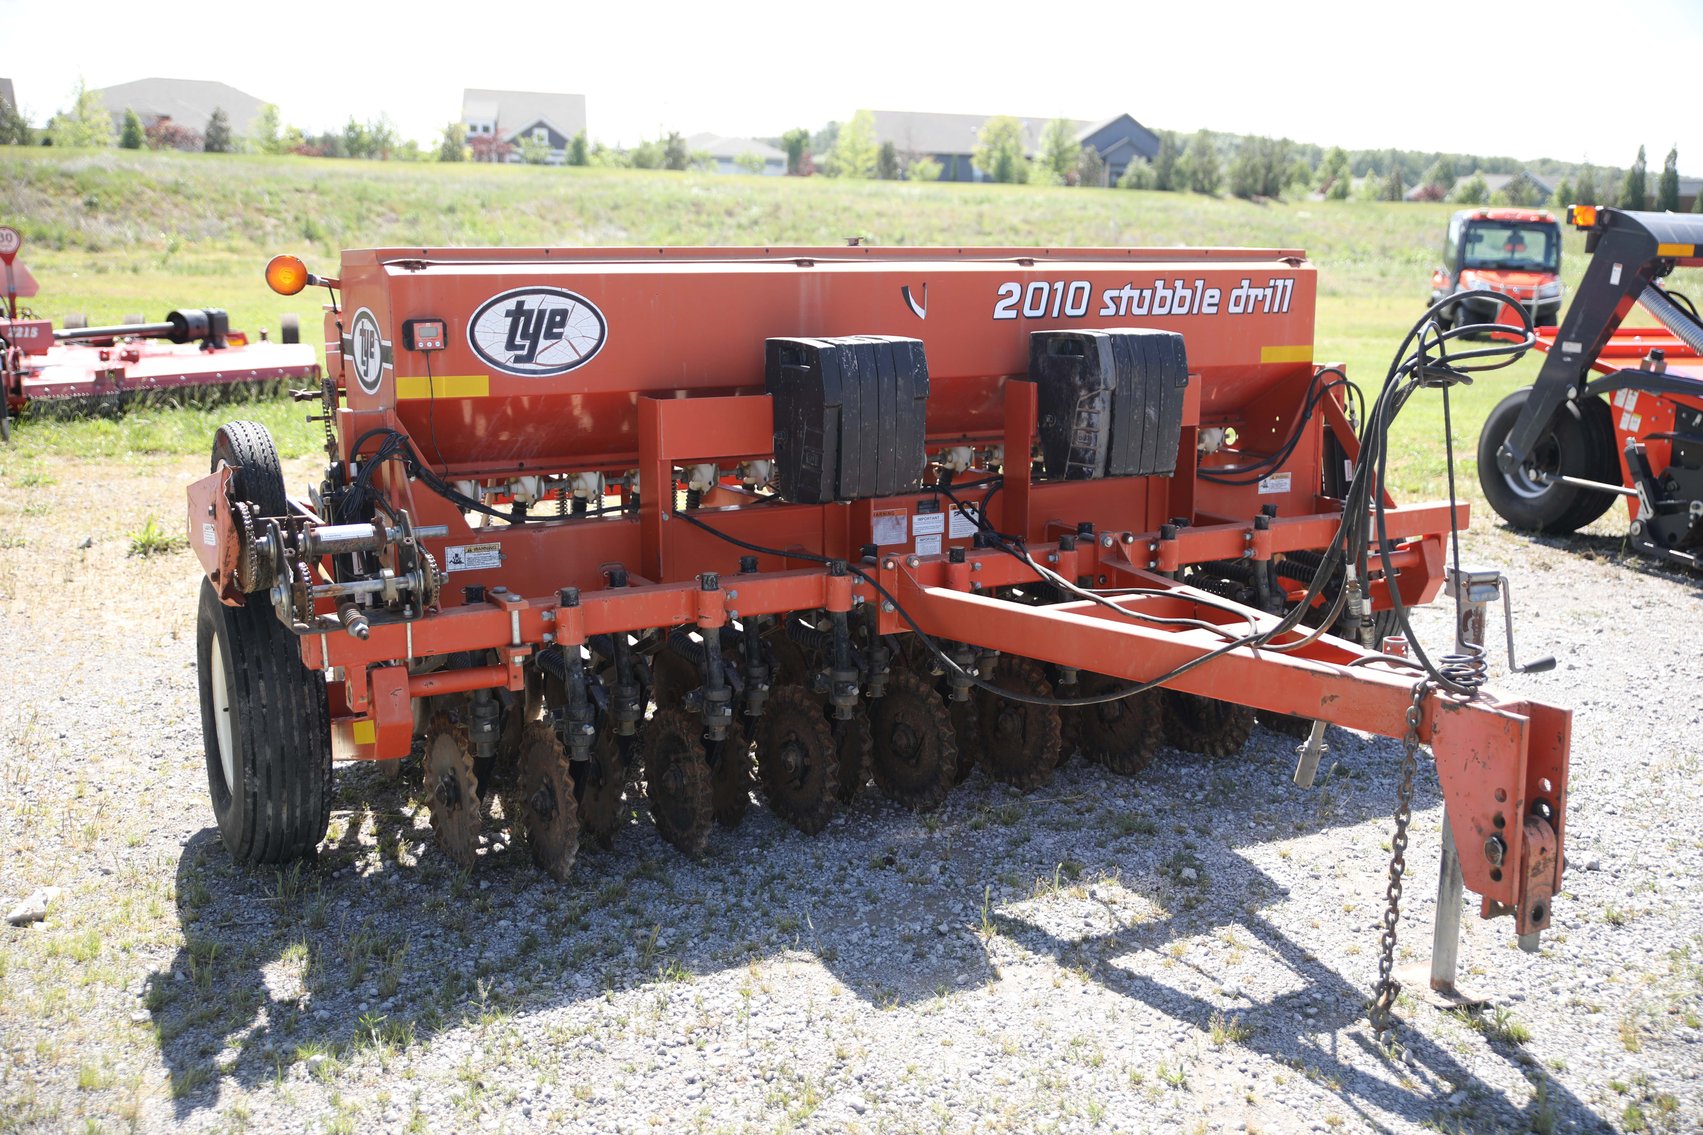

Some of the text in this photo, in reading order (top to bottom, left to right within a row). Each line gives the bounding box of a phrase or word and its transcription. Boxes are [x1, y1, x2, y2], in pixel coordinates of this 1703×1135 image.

[993, 277, 1295, 320] 2010 stubble drill
[359, 320, 375, 378] tye
[504, 300, 570, 364] tye
